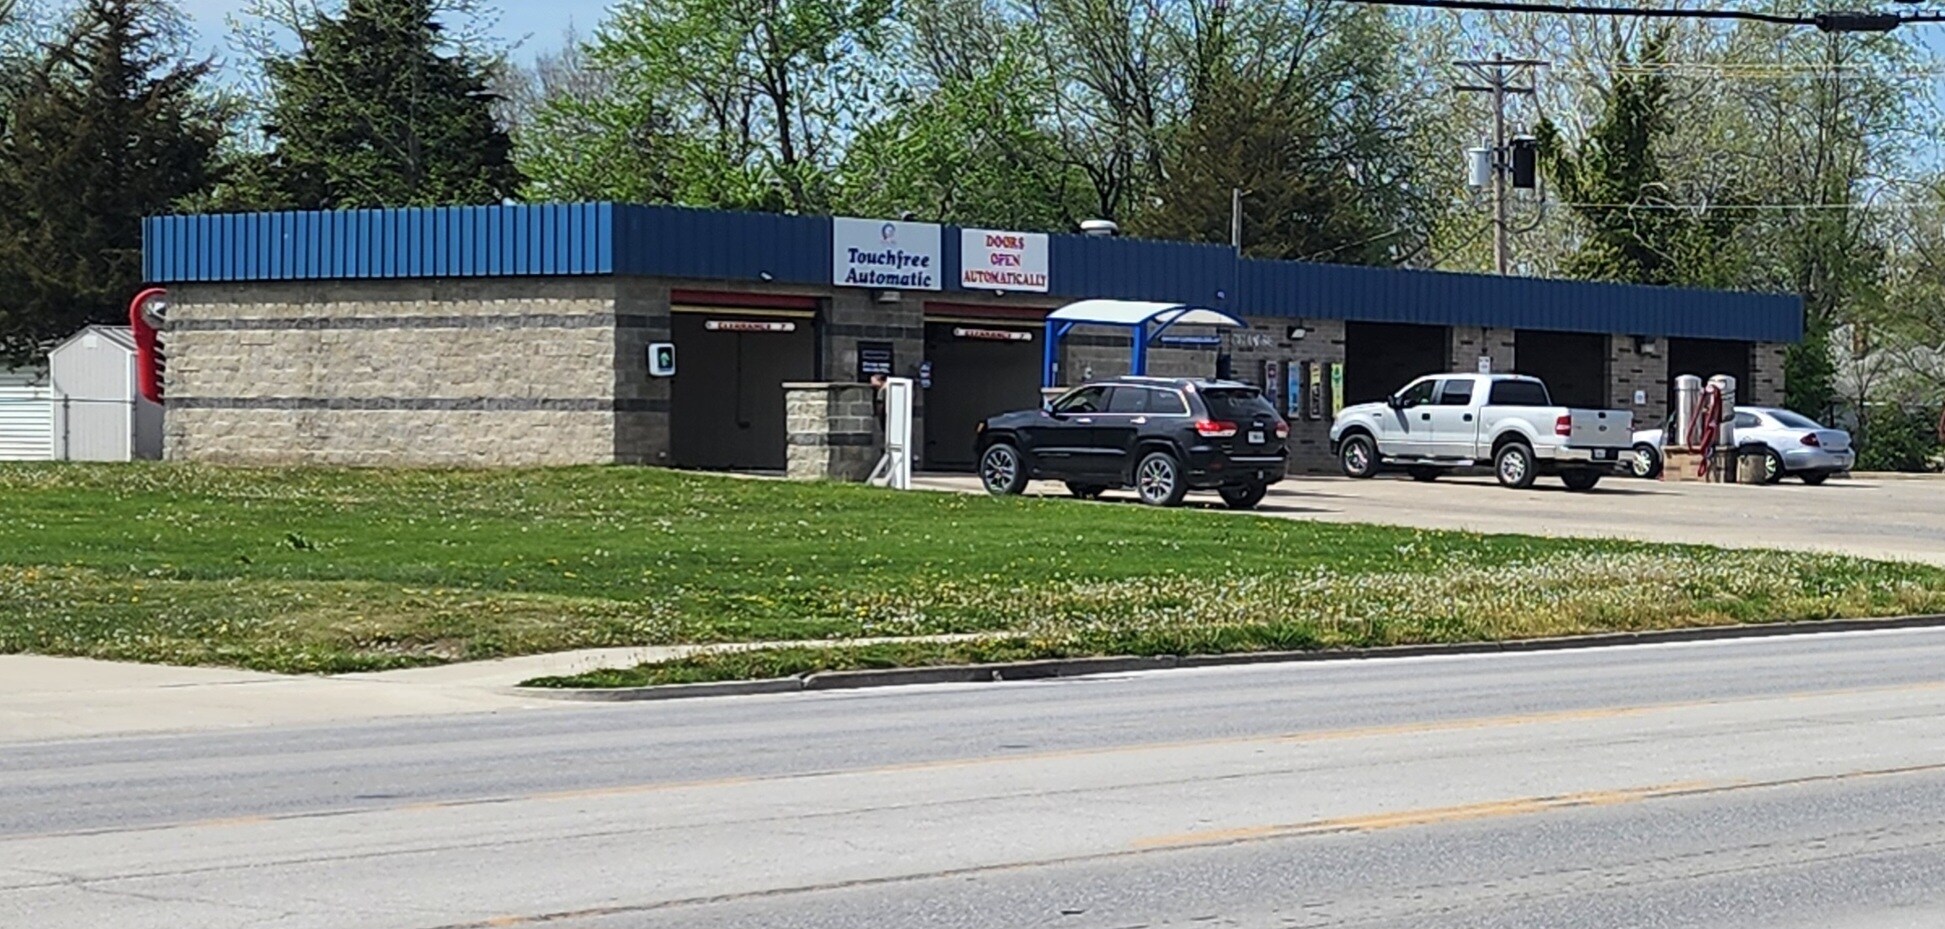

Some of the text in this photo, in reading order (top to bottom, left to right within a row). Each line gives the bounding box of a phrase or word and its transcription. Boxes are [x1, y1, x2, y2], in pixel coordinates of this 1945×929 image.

[985, 235, 1025, 249] DOORS
[848, 248, 930, 269] Touchfree
[990, 253, 1021, 266] OPEN
[845, 268, 932, 287] Automatic
[964, 270, 1046, 287] AUTOMATICALLY
